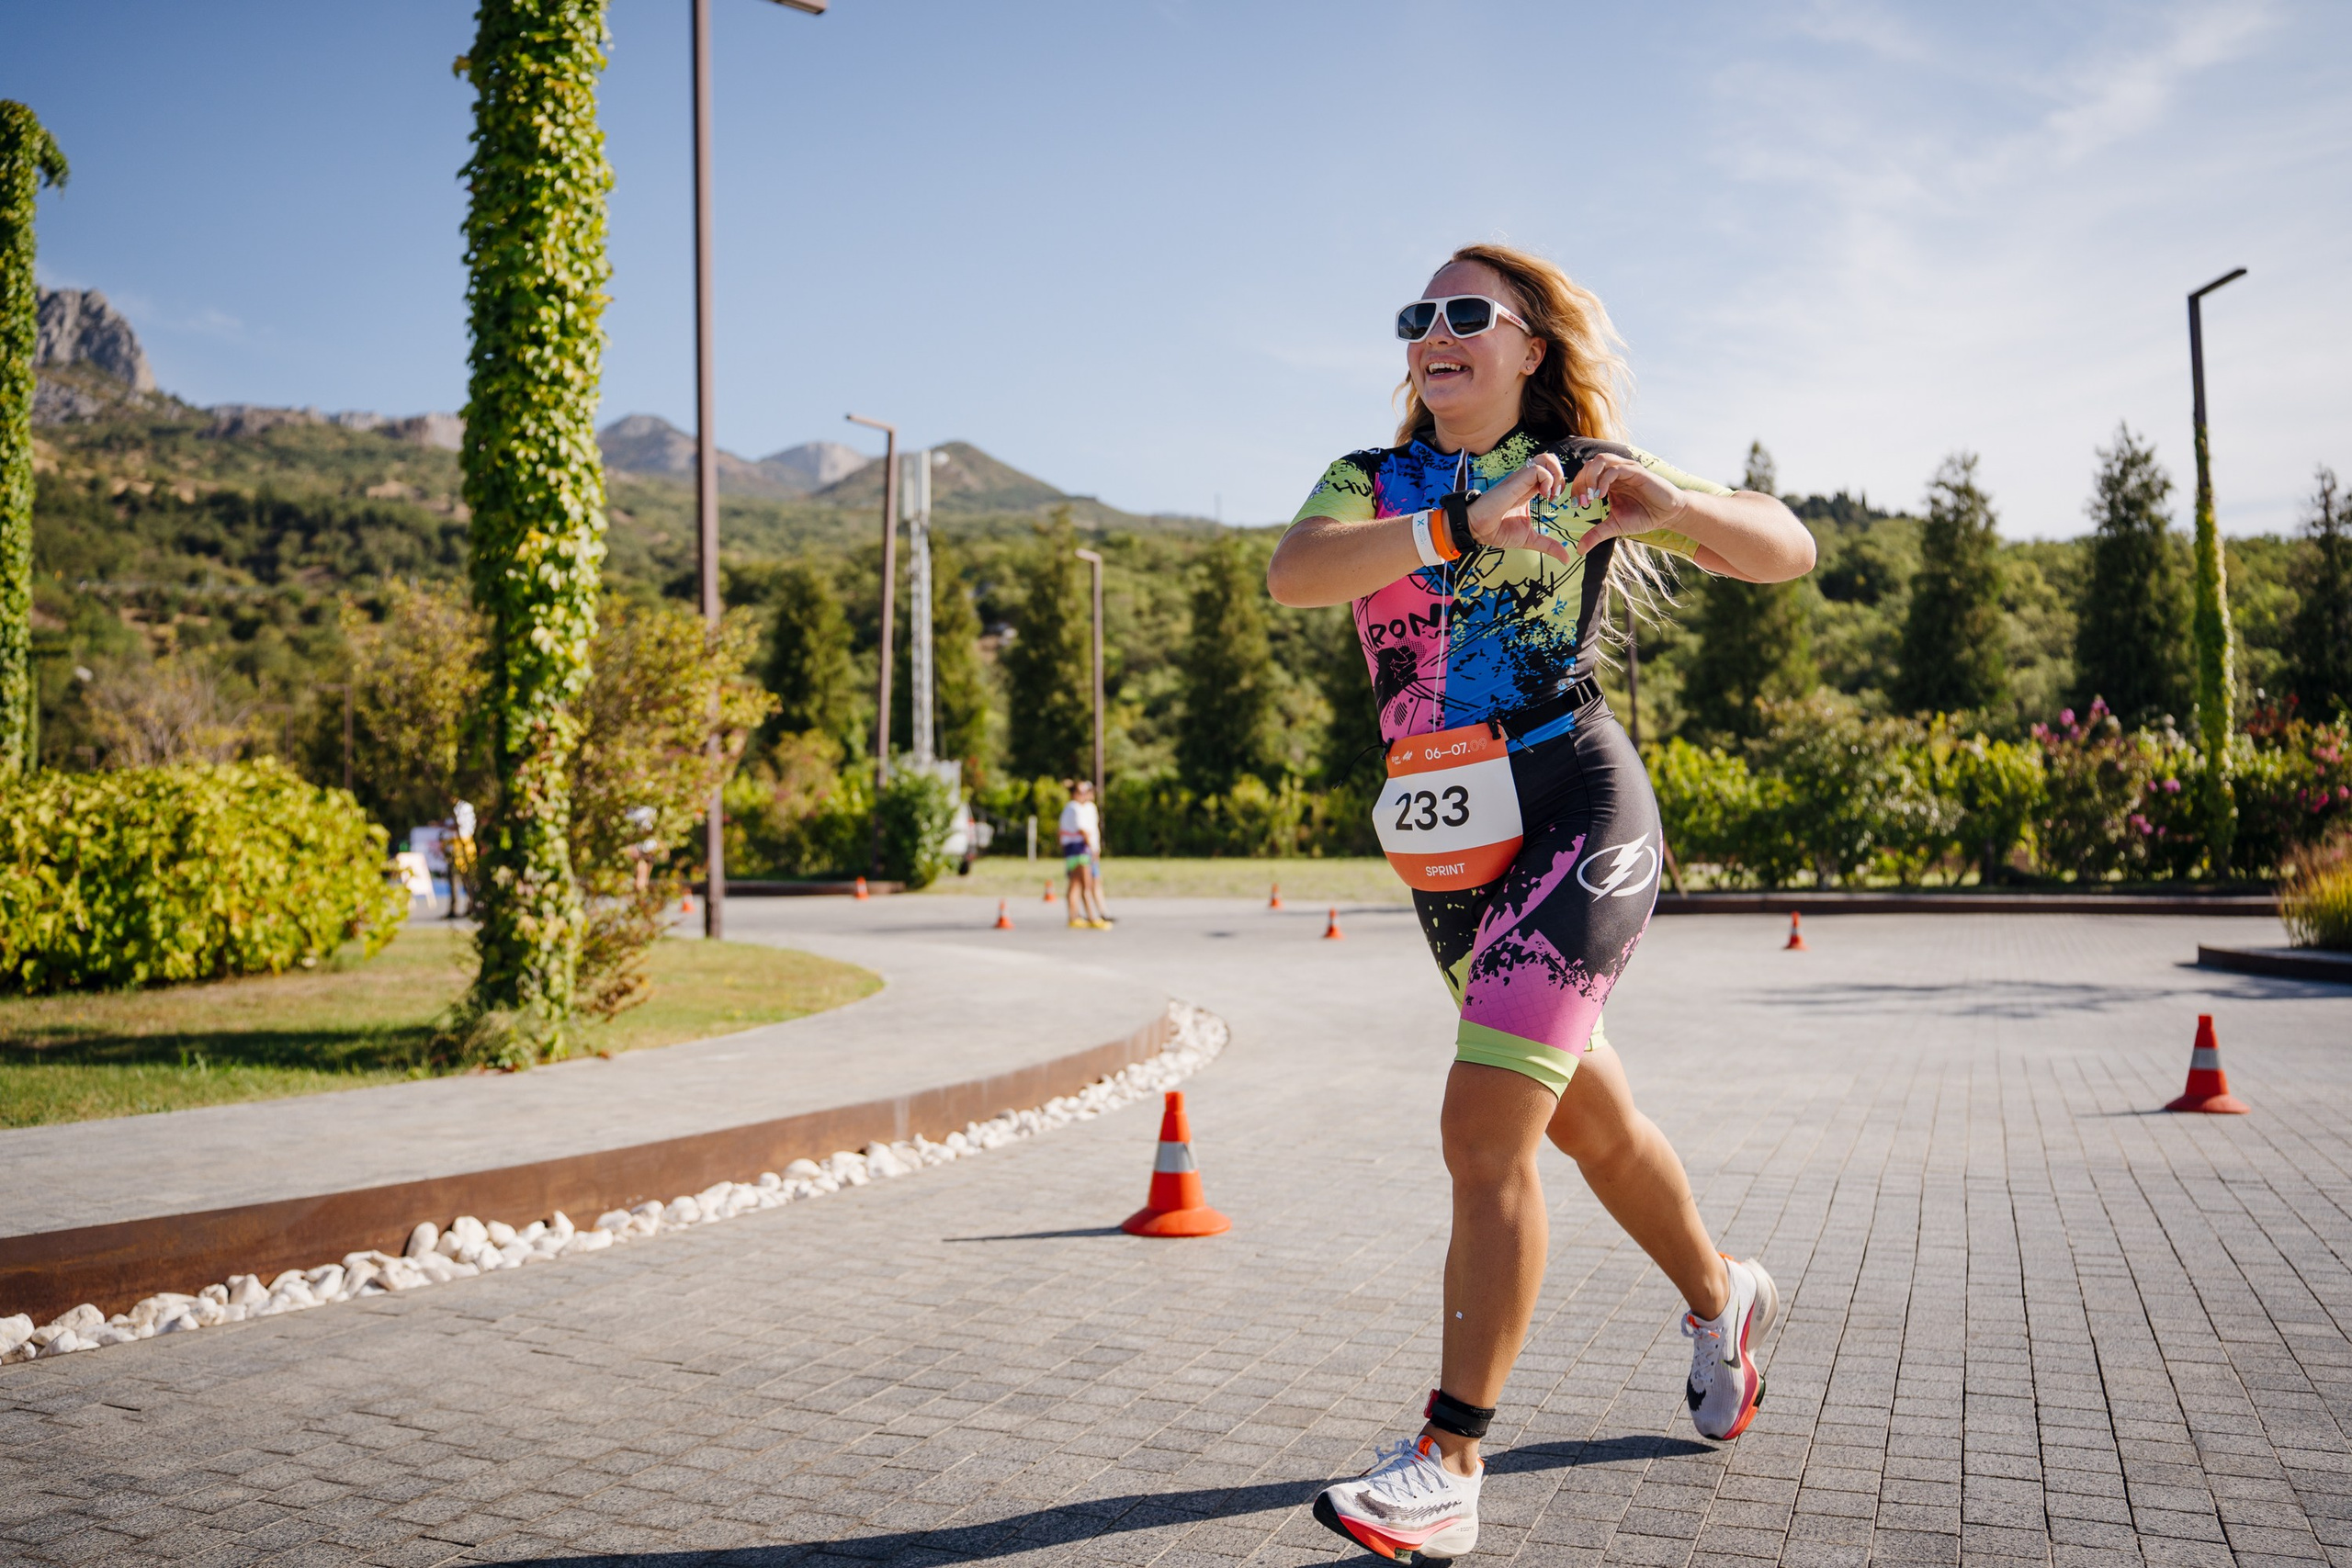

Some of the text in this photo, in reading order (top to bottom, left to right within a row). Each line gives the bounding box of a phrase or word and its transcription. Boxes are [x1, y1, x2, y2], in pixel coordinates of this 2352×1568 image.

[1364, 571, 1555, 650] IRONMAN
[1395, 784, 1470, 831] 233
[1425, 863, 1465, 876] SPRINT
